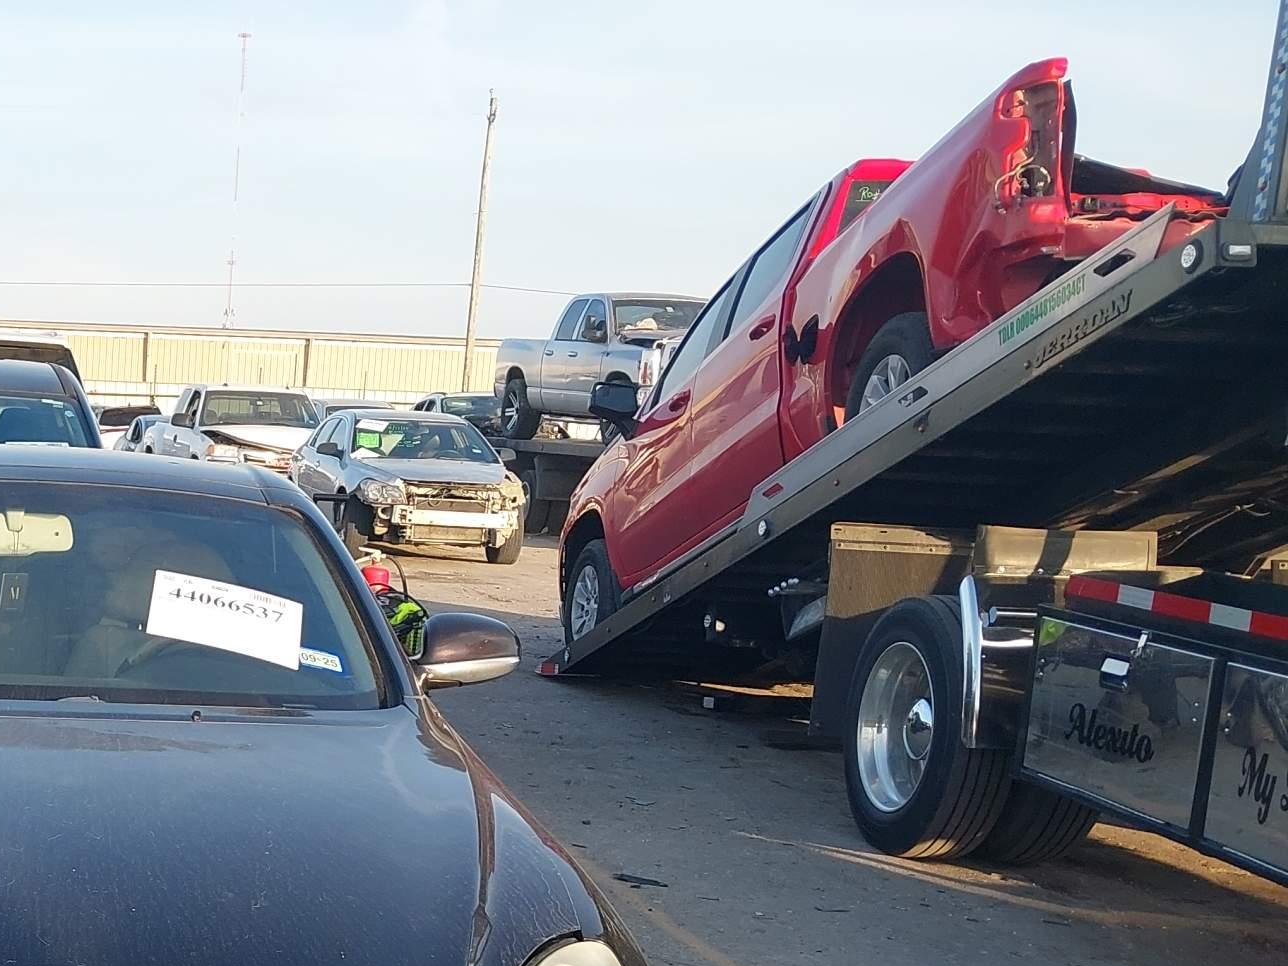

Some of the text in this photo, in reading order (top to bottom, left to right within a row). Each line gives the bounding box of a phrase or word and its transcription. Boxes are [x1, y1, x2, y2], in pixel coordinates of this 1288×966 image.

[168, 587, 284, 623] 44066537
[300, 652, 339, 668] 09-25
[1238, 746, 1277, 825] My
